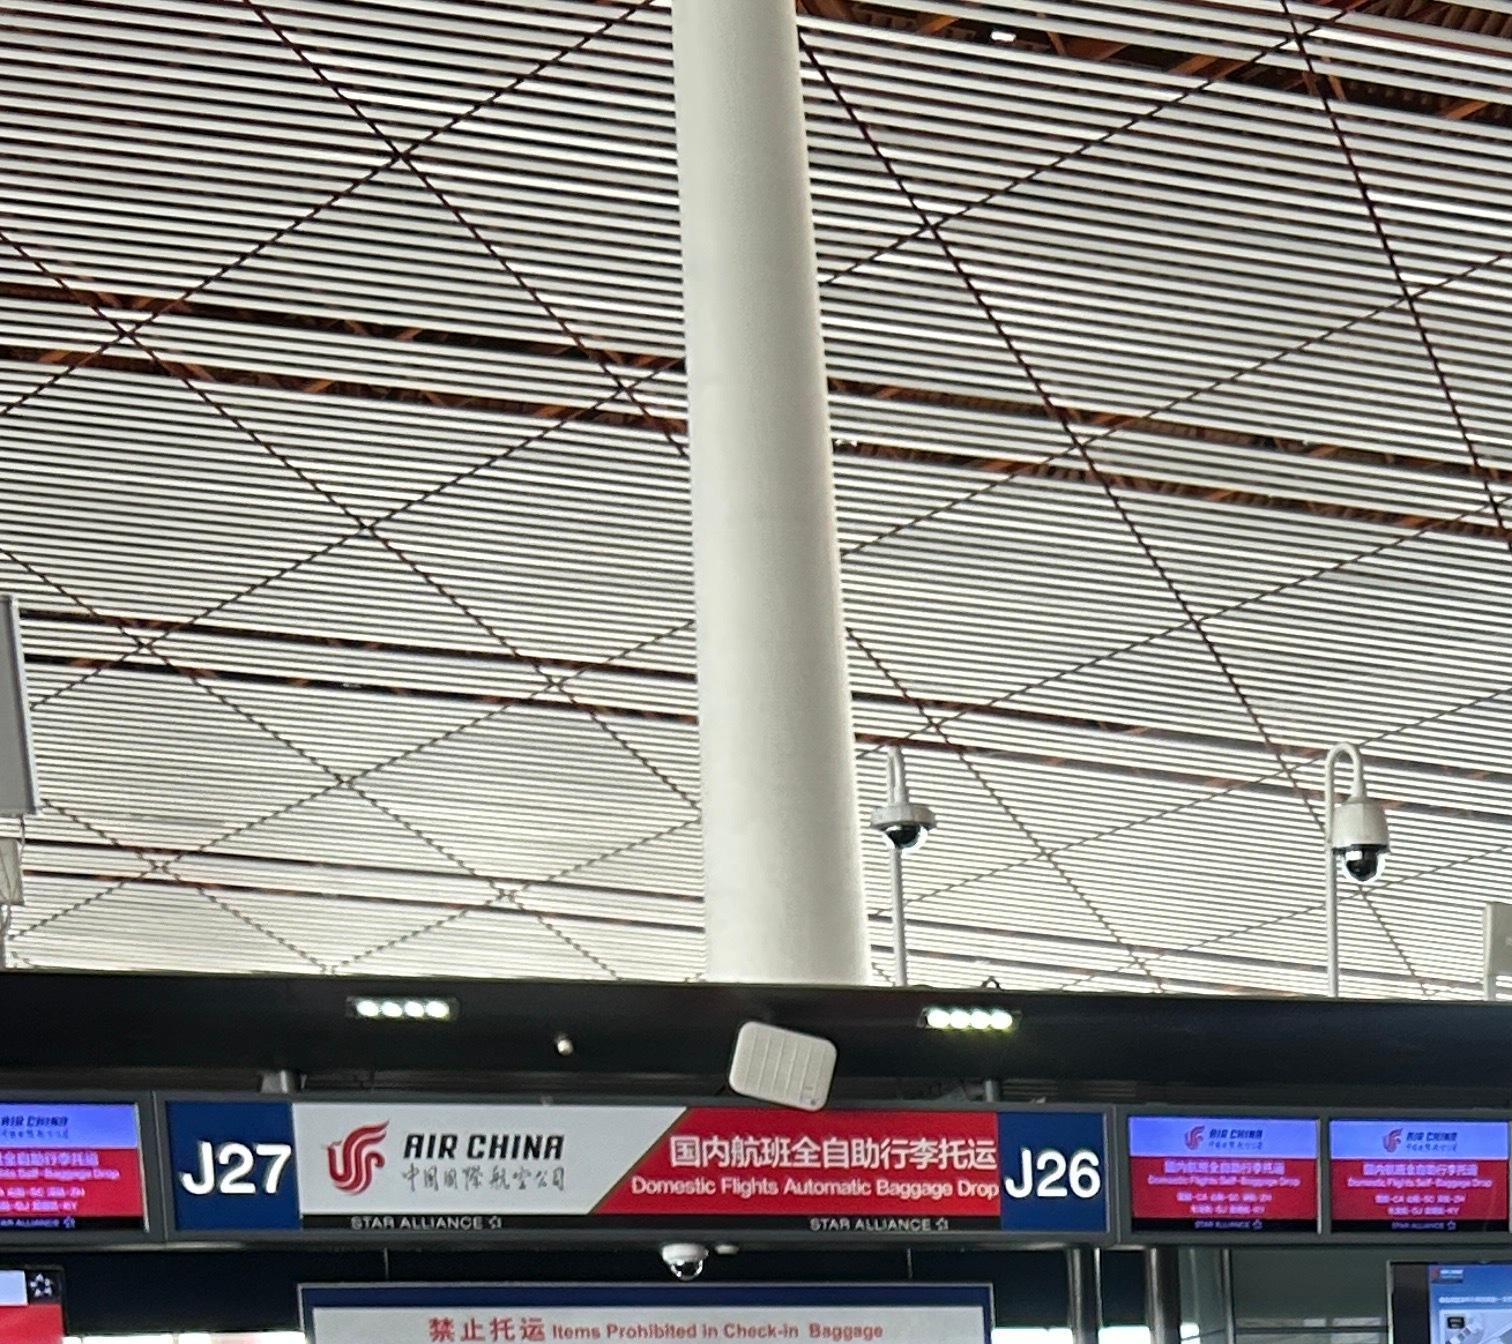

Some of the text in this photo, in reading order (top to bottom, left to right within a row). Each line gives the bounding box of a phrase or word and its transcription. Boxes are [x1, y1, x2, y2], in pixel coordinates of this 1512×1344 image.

[403, 1133, 566, 1161] AIR CHINA
[669, 1135, 998, 1170] 国内航班全自助行李托运
[180, 1142, 292, 1195] J27
[1004, 1148, 1101, 1199] J26
[631, 1177, 999, 1200] Domestic Flights Automatic Baggage Drop
[350, 1216, 484, 1230] STAR ALLIANCE
[809, 1218, 932, 1231] STAR ALLIANCE
[428, 1316, 885, 1343] 禁止托运 Items Prohibited in Check-in Baggage
